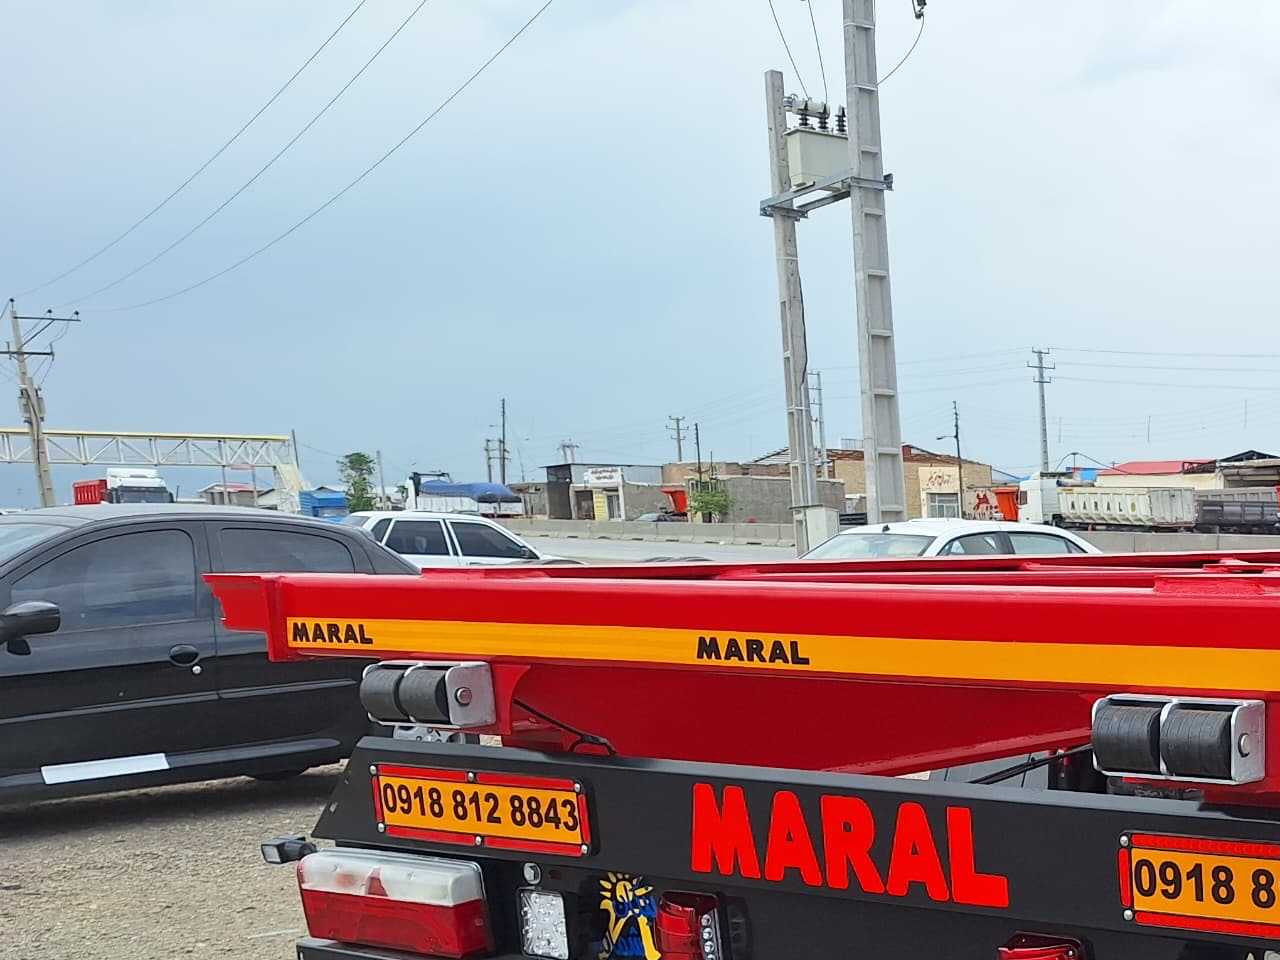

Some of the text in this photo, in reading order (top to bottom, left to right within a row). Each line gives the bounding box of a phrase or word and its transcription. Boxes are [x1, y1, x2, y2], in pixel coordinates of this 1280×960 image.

[291, 622, 374, 645] MARAL
[696, 636, 811, 666] MARAL
[382, 782, 579, 832] 0918 812 8843
[691, 783, 1010, 909] MARAL
[1133, 857, 1236, 905] 0918
